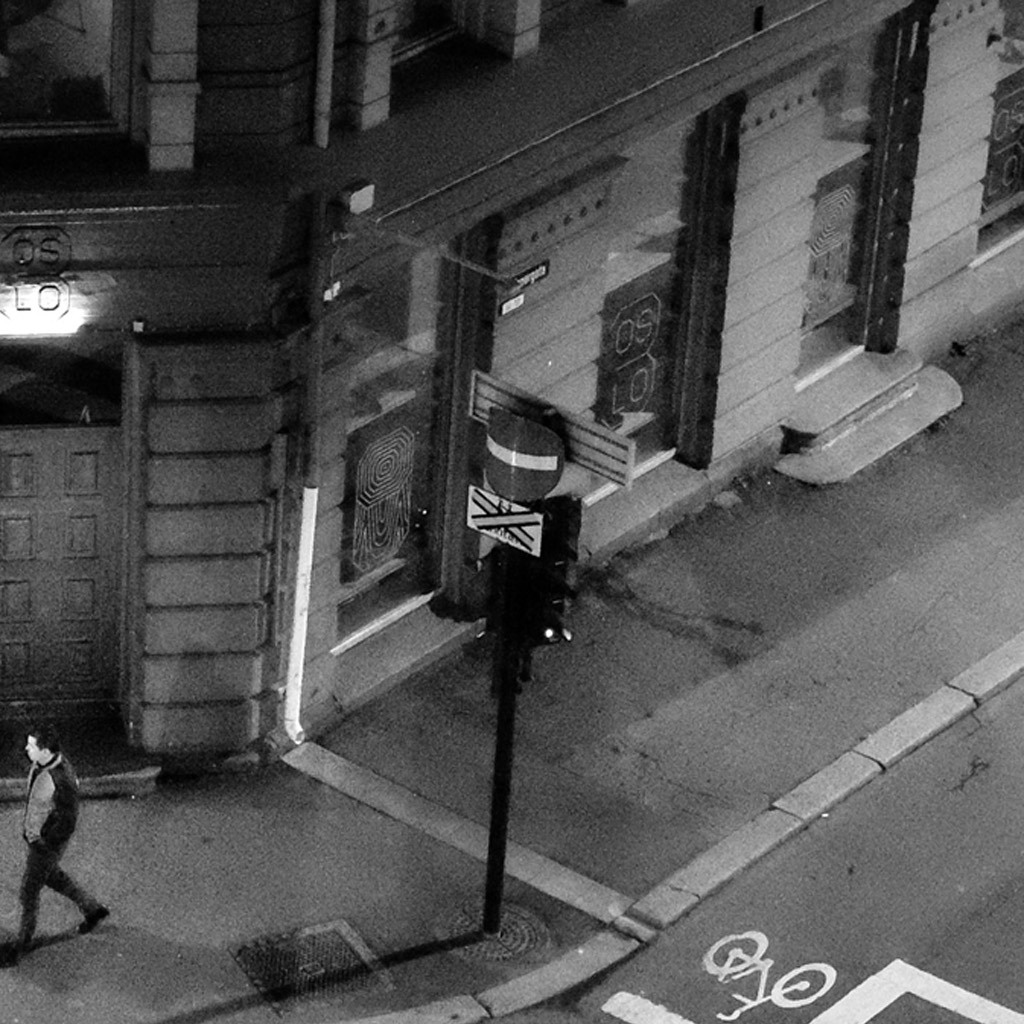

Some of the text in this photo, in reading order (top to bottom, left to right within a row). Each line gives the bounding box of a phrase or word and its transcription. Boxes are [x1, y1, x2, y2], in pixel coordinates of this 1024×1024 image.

[12, 238, 61, 266] OS
[14, 285, 60, 312] LO
[616, 308, 653, 354] OS
[612, 368, 649, 415] LO
